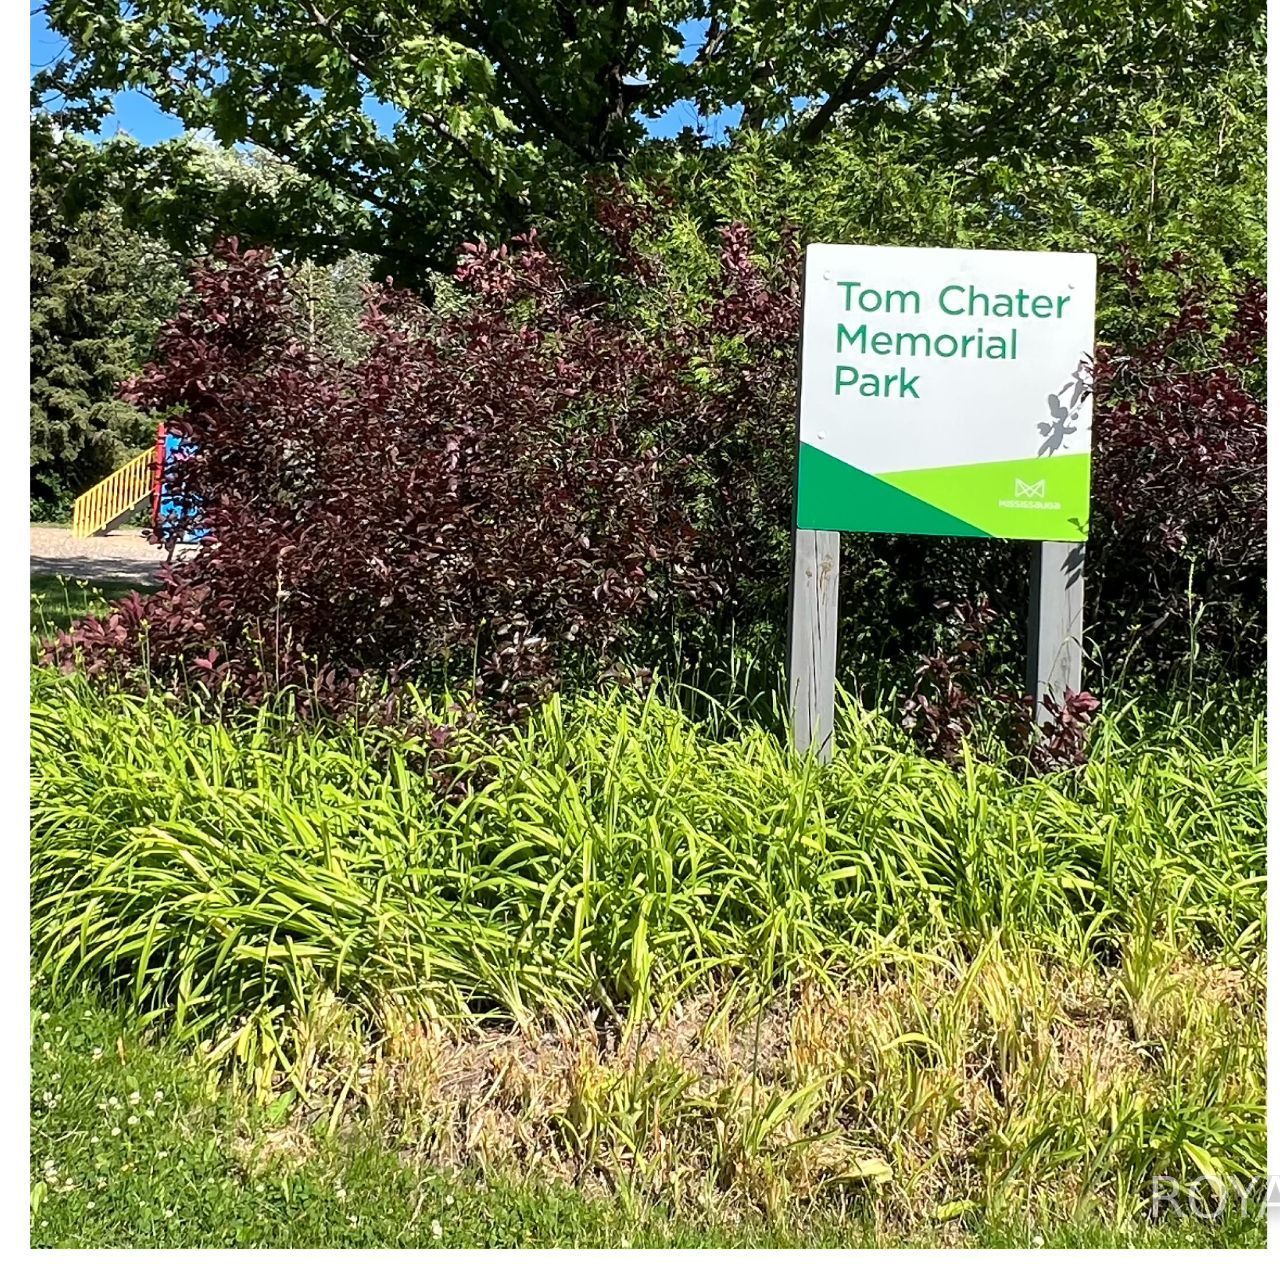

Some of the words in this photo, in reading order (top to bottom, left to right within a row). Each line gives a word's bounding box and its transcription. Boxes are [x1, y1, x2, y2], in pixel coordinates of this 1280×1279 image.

[836, 281, 921, 314] Tom
[938, 284, 1071, 318] Chater
[836, 323, 1017, 360] Memorial
[834, 365, 921, 399] Park
